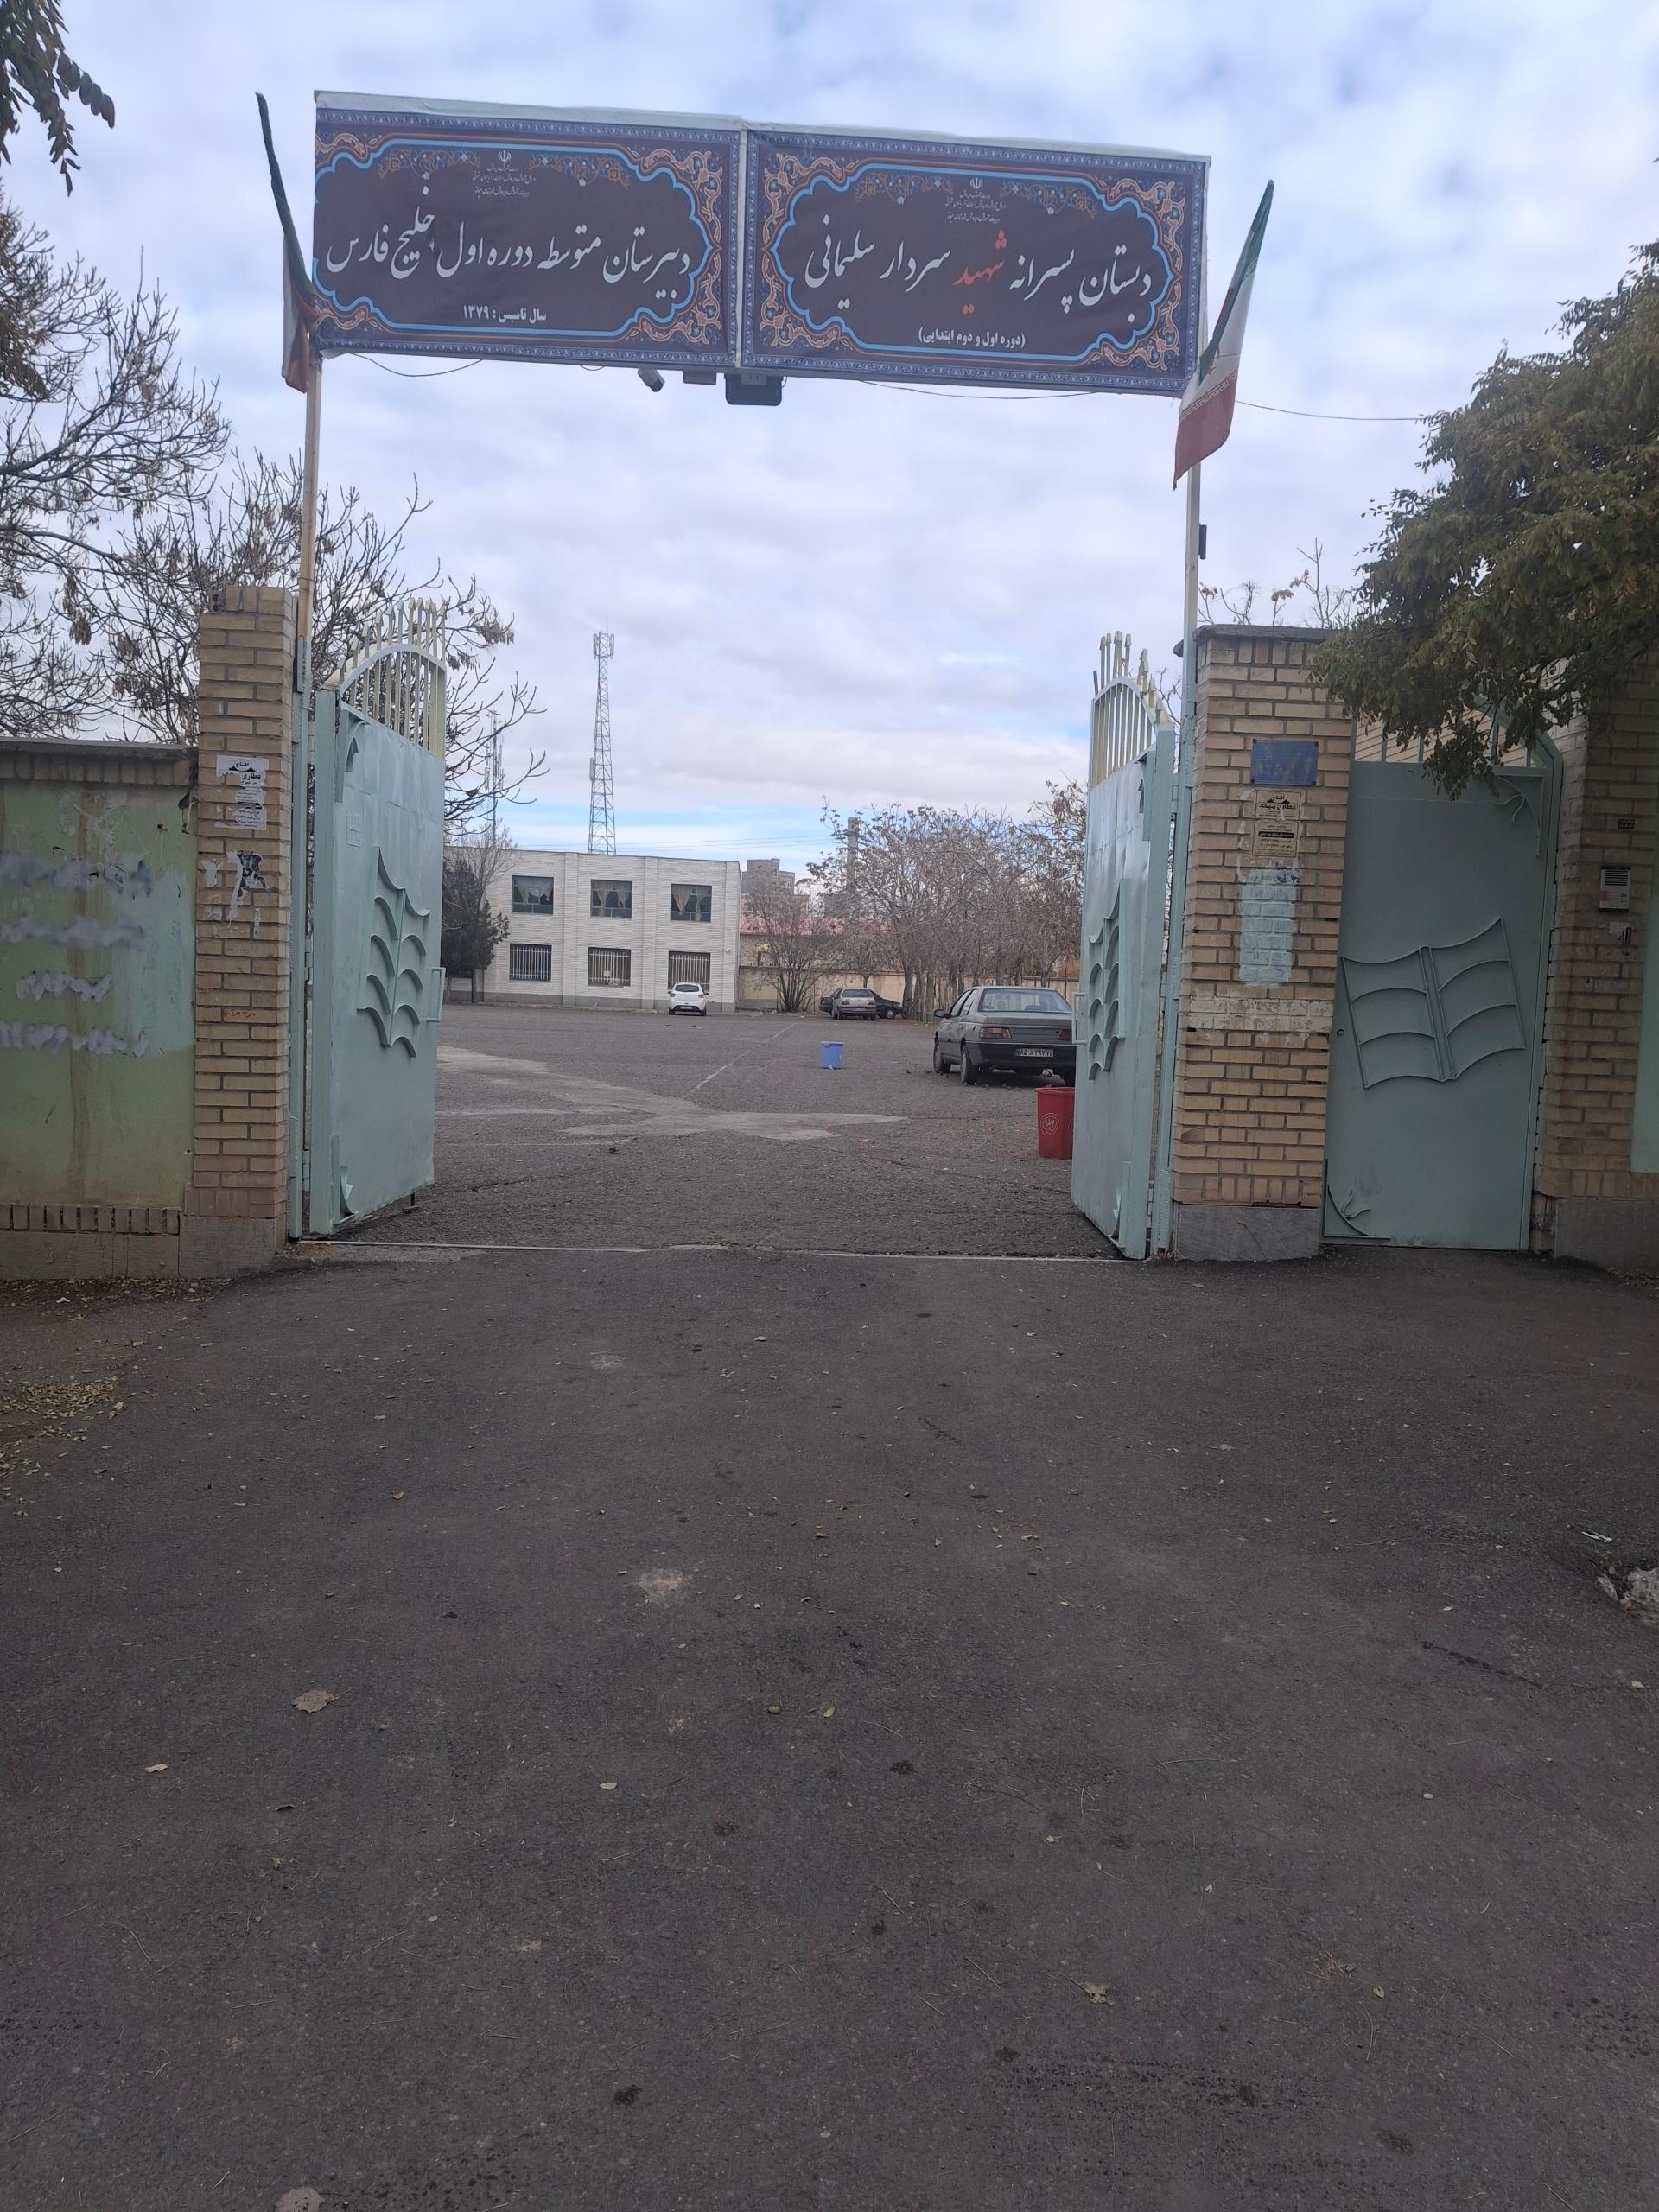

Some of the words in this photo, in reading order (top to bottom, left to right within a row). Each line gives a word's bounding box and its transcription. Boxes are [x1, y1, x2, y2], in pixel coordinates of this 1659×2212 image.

[326, 223, 389, 273] فارس
[391, 185, 435, 279] خلیج
[436, 220, 484, 278] اول
[537, 224, 601, 270] متوسطه
[486, 245, 534, 269] دوره
[603, 226, 690, 299] دبیرستان
[804, 213, 876, 310] سلیمانی
[879, 240, 950, 294] سردار
[952, 229, 1008, 315] شهید
[1008, 248, 1075, 315] پسرانه
[1079, 244, 1152, 323] دبستان
[463, 304, 490, 321] ۱۳۷۹
[499, 307, 527, 323] تاسیس
[529, 308, 547, 324] سال
[956, 332, 973, 346] دوم
[975, 334, 981, 346] و
[982, 331, 999, 347] اول
[1000, 332, 1026, 349] (دوره
